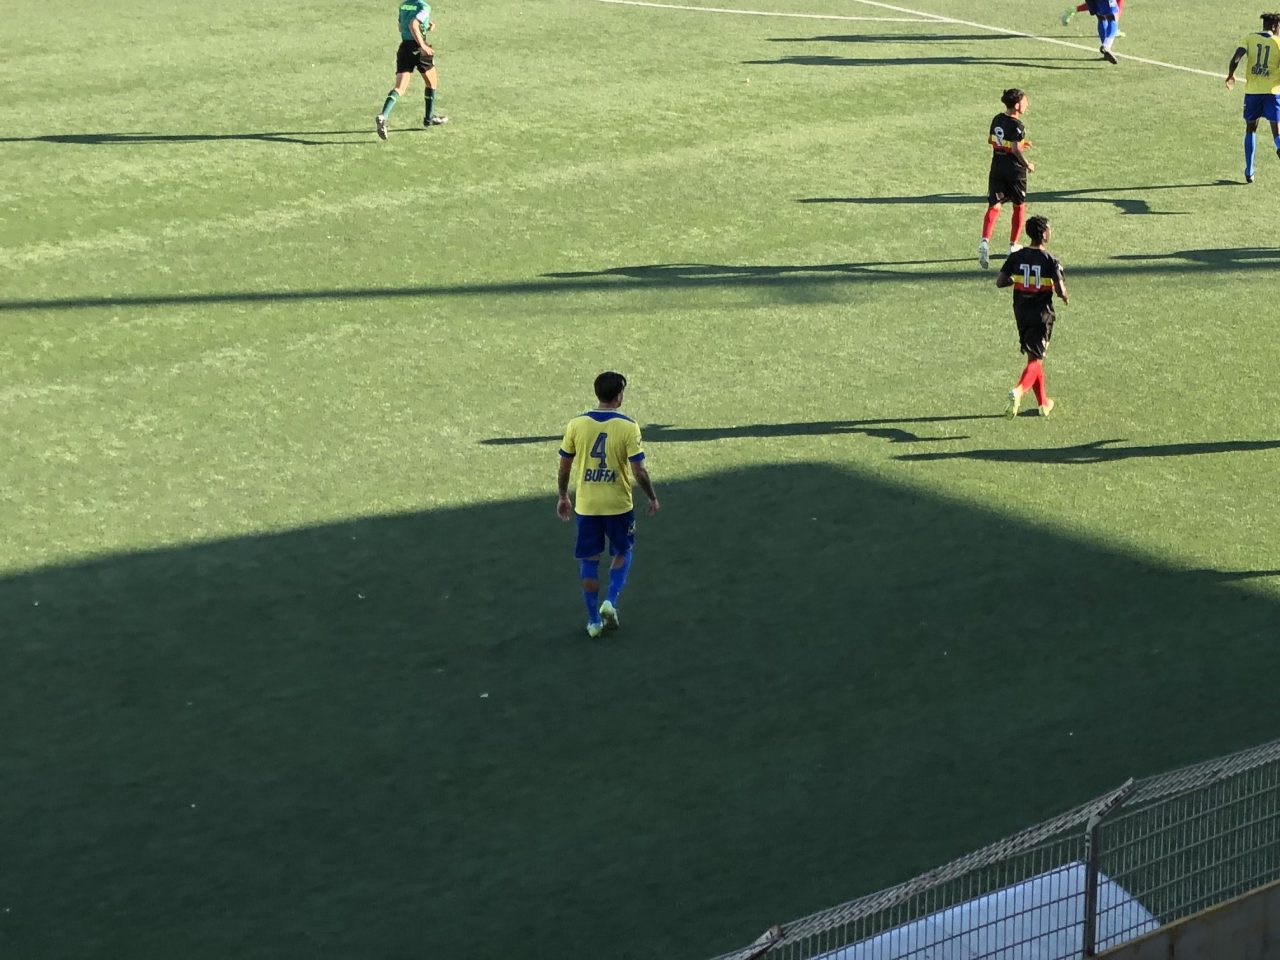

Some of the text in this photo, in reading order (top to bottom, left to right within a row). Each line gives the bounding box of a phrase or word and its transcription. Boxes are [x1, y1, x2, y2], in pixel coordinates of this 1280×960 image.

[1256, 43, 1270, 69] 11
[994, 126, 1005, 147] 9
[1020, 263, 1041, 289] 11
[590, 432, 608, 469] 4
[584, 468, 616, 483] BUFFA
